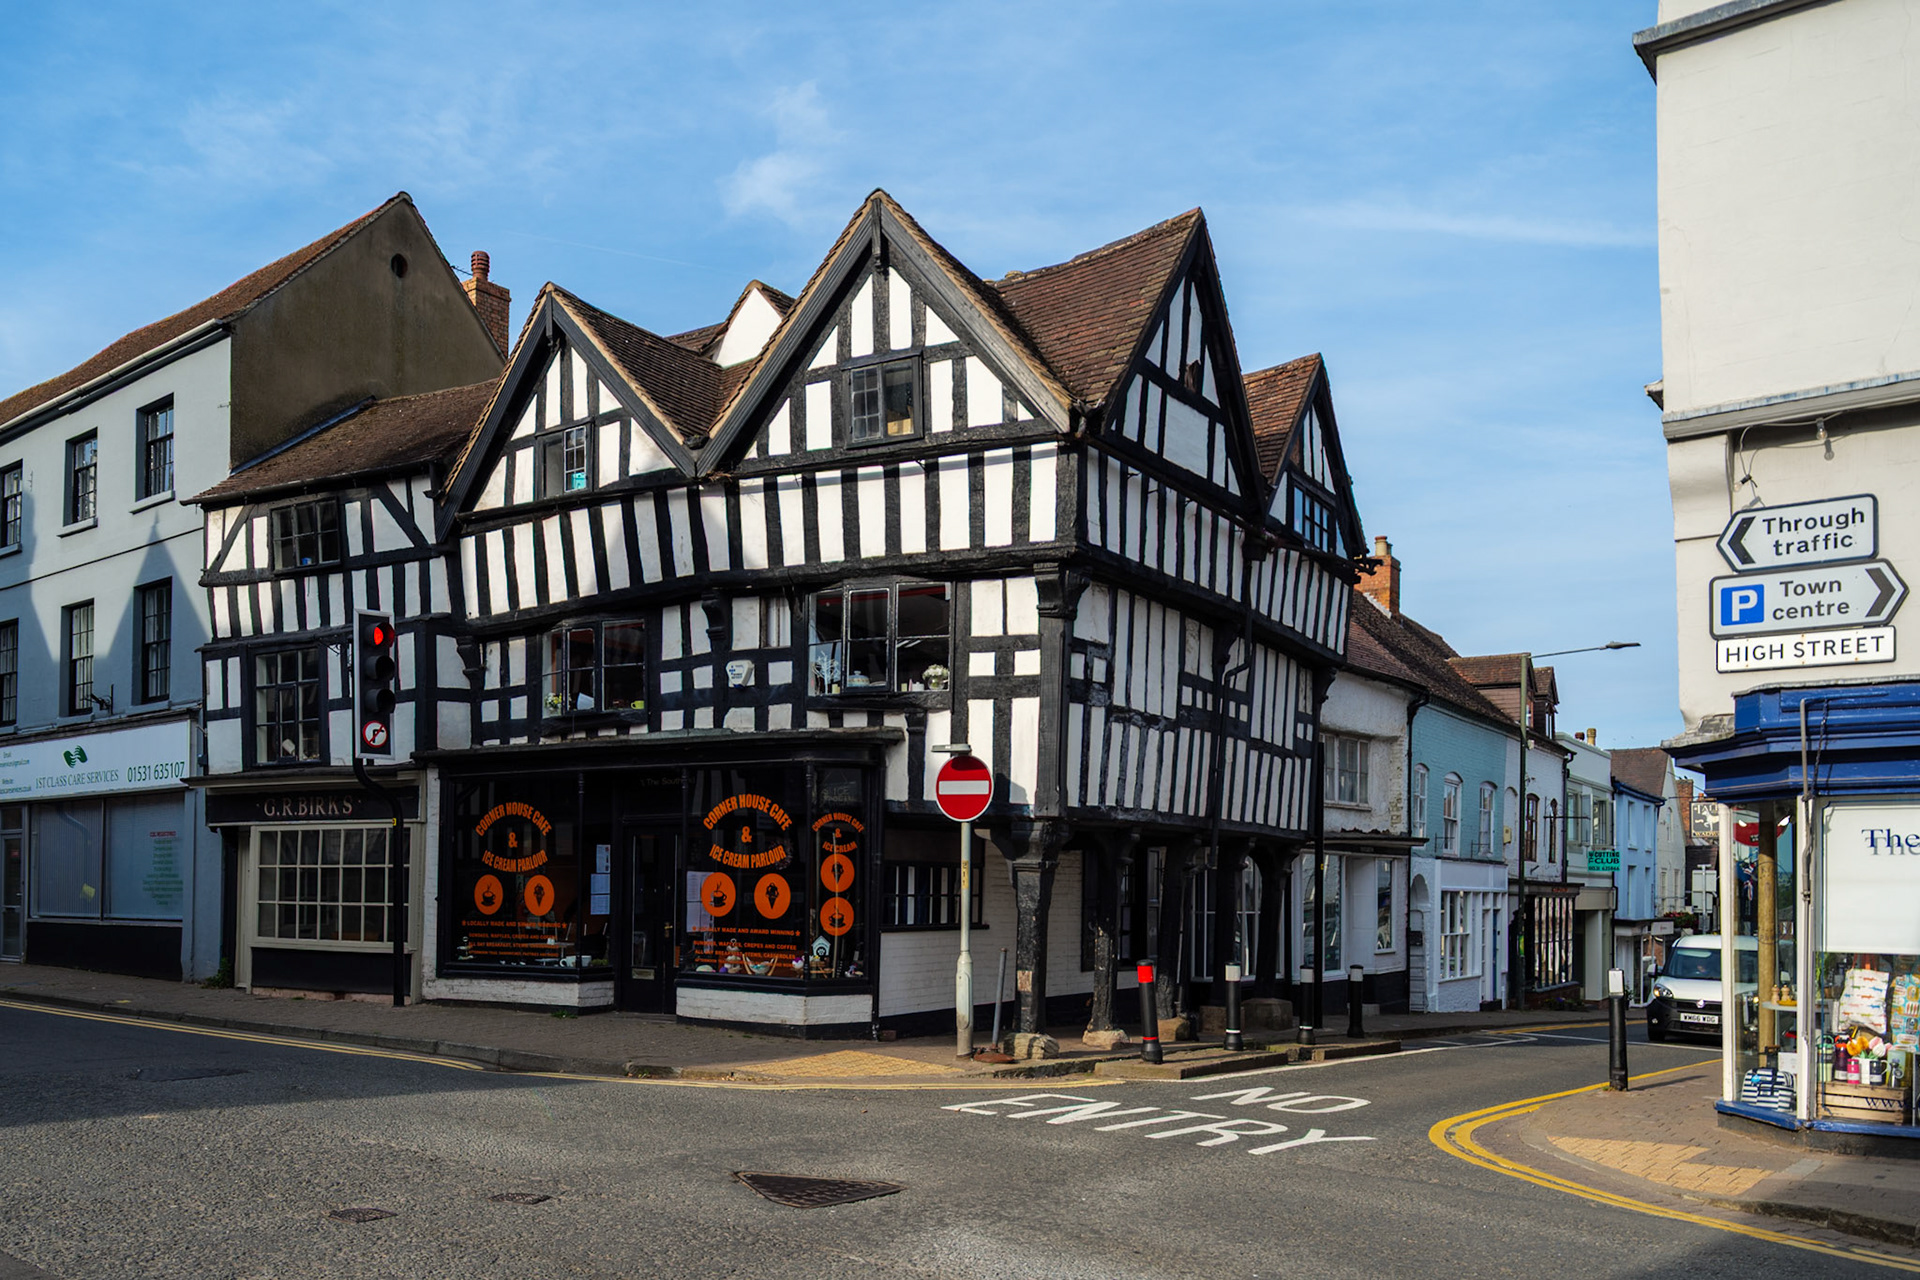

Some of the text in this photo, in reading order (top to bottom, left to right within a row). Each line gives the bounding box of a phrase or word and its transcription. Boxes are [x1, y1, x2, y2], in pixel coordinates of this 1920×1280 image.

[1762, 507, 1865, 535] Through
[1773, 532, 1853, 556] traffic
[1779, 579, 1842, 598] Town
[1731, 589, 1758, 622] P
[1772, 600, 1850, 621] centre
[1725, 635, 1885, 663] HIGH STREET
[46, 775, 67, 788] CLASS
[67, 772, 85, 786] CARE
[86, 769, 119, 784] SERVICES
[127, 761, 186, 783] 01531 635107
[475, 802, 552, 836] CORNER HOUSE CAFE
[703, 793, 793, 831] CORNER HOUSE CAFE
[811, 813, 833, 832] CORNER
[833, 812, 853, 824] HOUSE
[508, 832, 518, 848] &
[741, 826, 753, 843] &
[834, 827, 842, 838] &
[1861, 828, 1920, 848] The
[709, 843, 787, 869] ICE CREAM PARLOUR
[822, 841, 858, 853] ICE CREAM
[482, 849, 548, 873] ICE CREAM PARLOUR
[1594, 857, 1620, 865] CLUB
[1190, 1086, 1372, 1114] NO
[940, 1093, 1377, 1156] ENTRY
